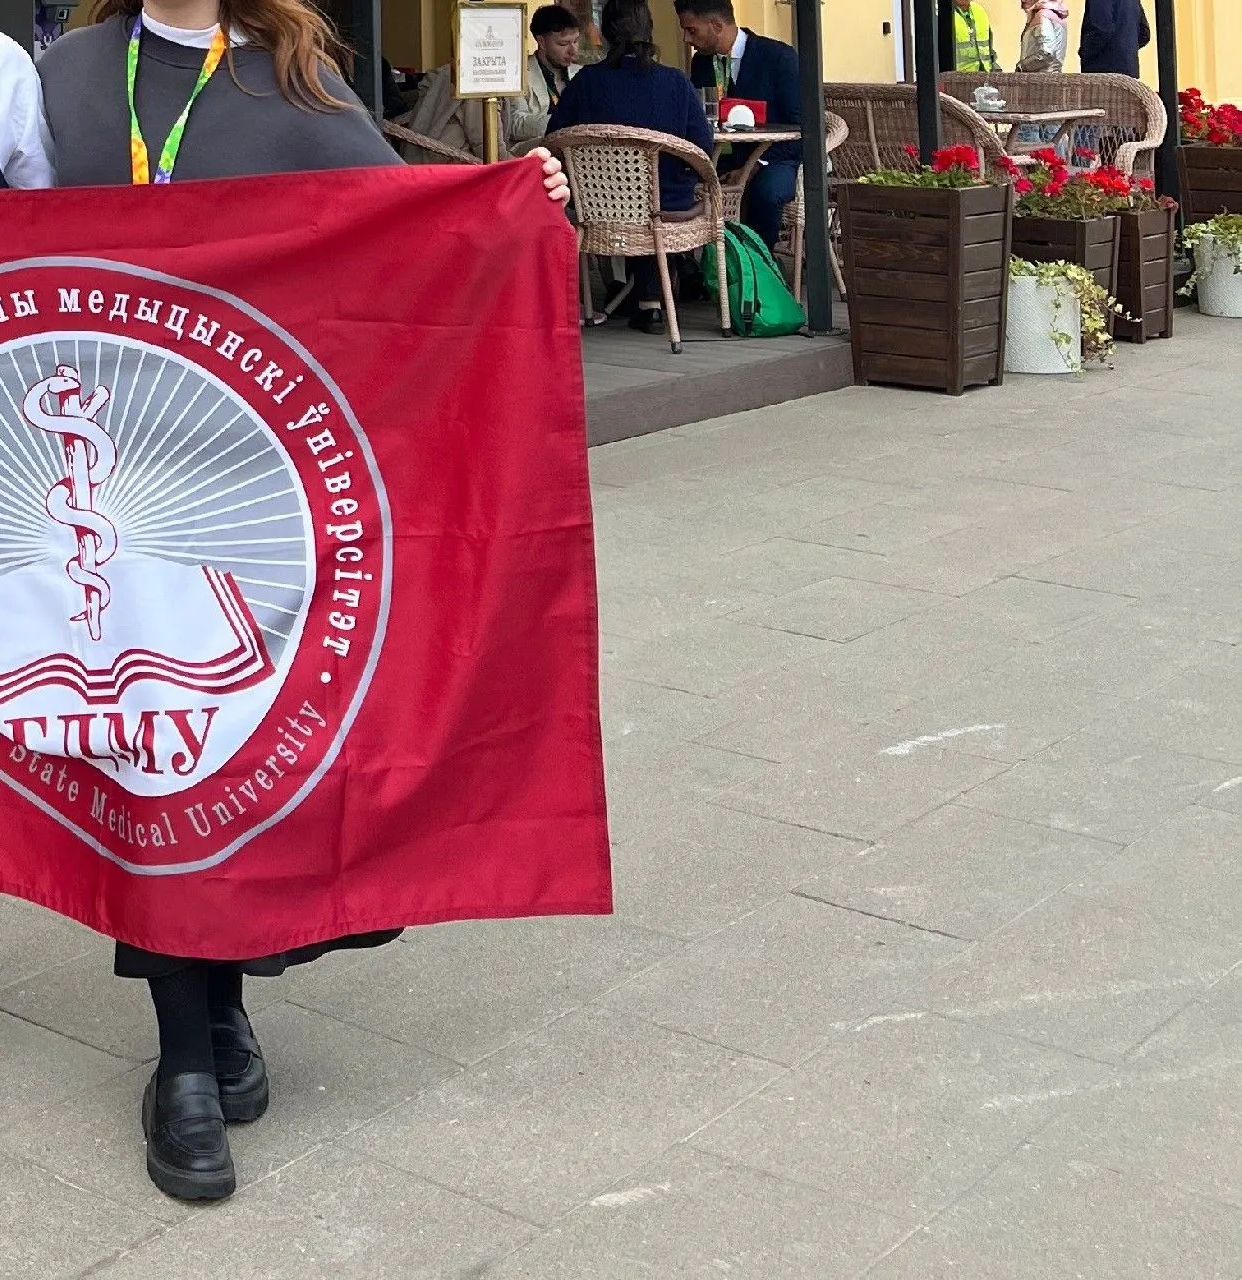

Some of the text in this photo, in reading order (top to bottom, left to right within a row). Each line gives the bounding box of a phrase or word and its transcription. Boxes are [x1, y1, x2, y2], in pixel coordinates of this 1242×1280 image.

[57, 288, 304, 405] медыцынскі
[287, 402, 373, 658] ўніверсітэт
[9, 744, 79, 802] State
[90, 786, 178, 848] Medical
[184, 700, 327, 838] University
